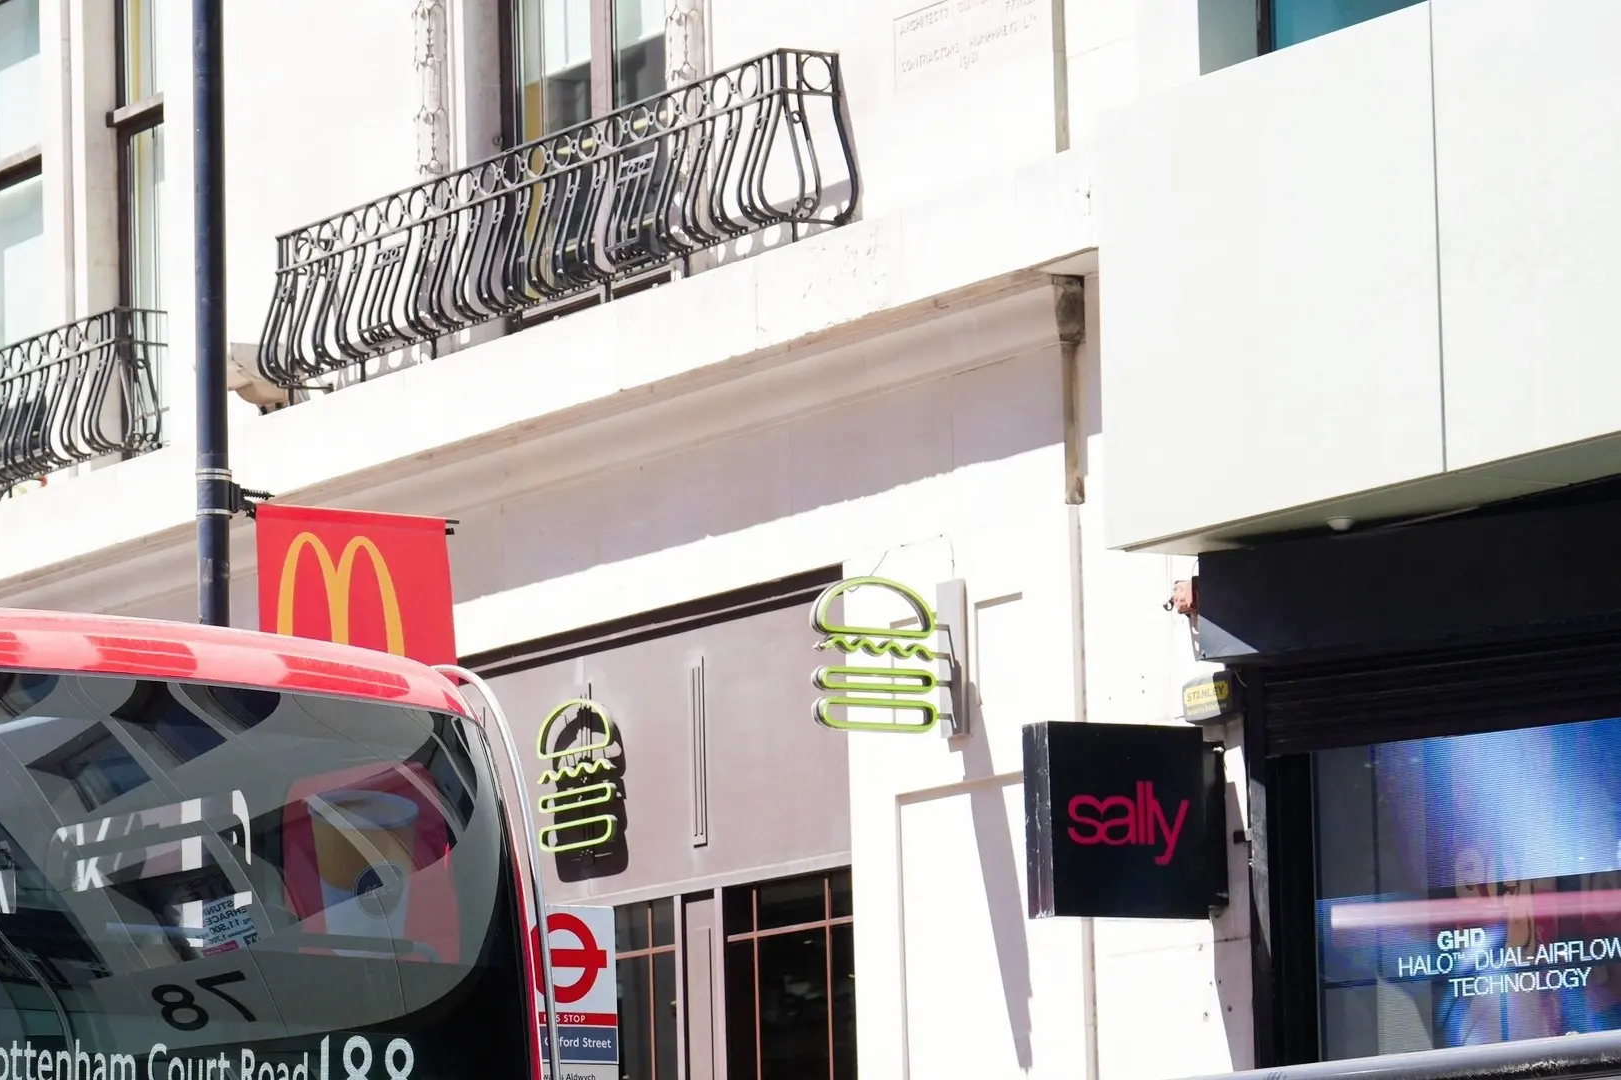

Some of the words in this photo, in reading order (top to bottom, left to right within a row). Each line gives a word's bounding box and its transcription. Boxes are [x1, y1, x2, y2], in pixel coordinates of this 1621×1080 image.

[1187, 685, 1224, 702] STANLEY
[1067, 781, 1189, 865] sally
[1437, 928, 1486, 950] GHD
[1475, 937, 1621, 971] DUAL-AIRFLOW
[1449, 967, 1591, 997] TECHNOLOGY
[564, 1014, 585, 1022] STOP
[545, 1036, 579, 1047] ford
[583, 1037, 611, 1048] Street
